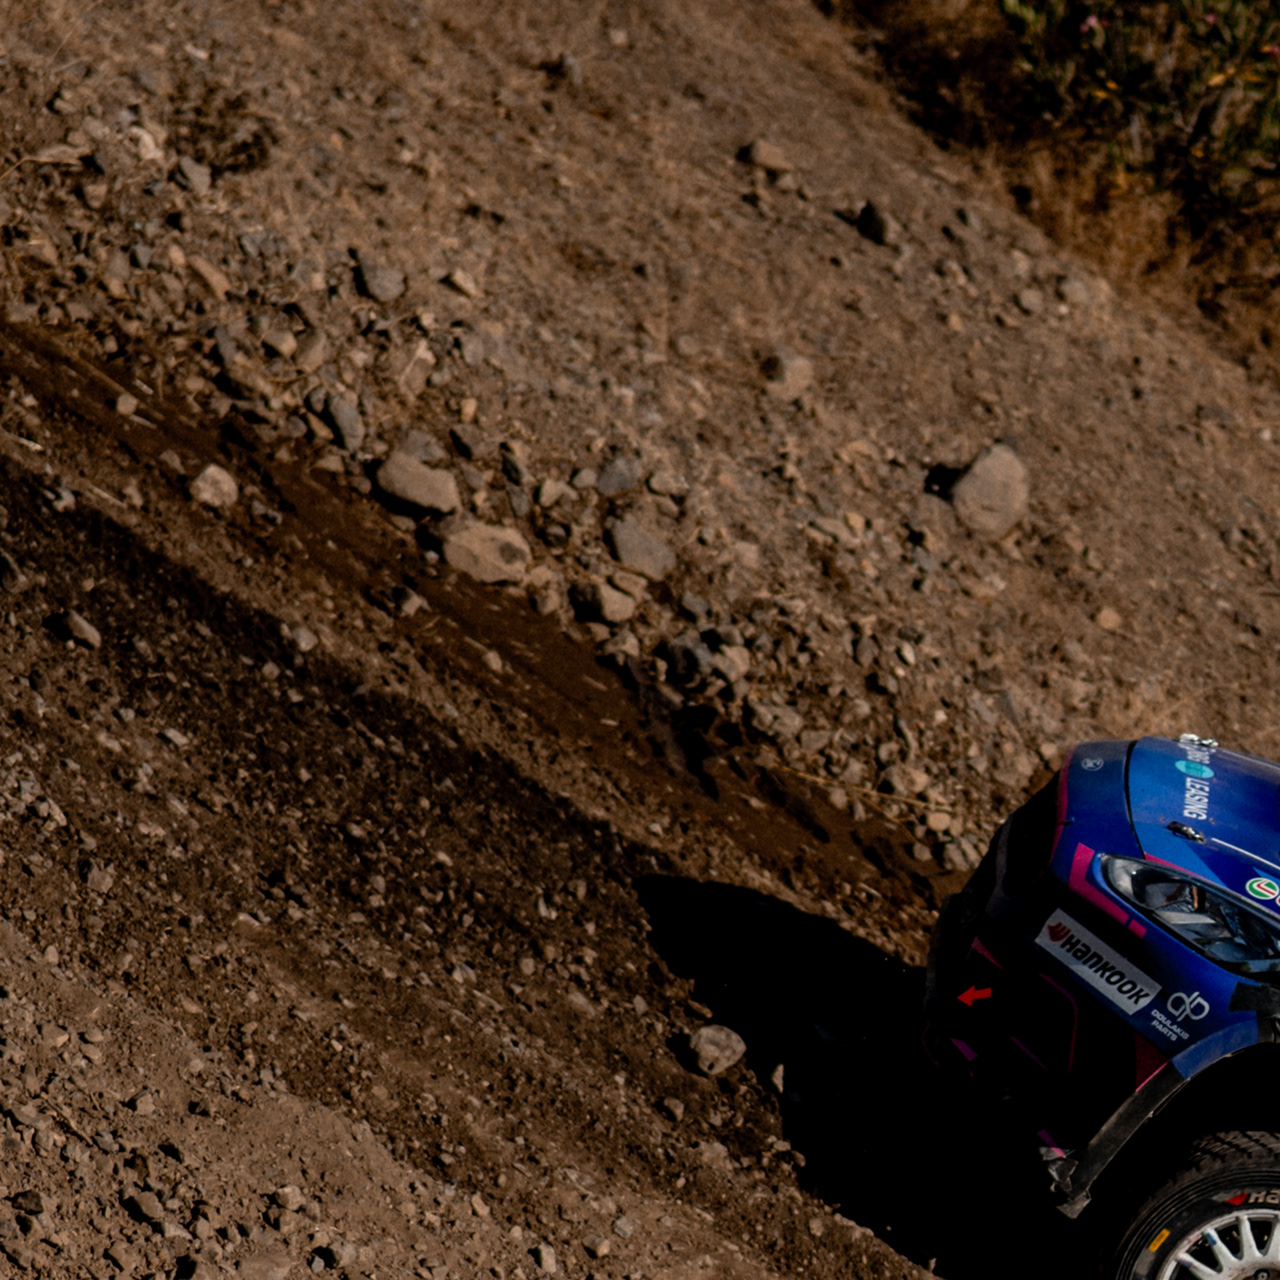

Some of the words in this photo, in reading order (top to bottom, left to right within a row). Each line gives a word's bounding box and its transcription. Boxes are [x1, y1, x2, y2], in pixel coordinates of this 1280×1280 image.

[1183, 777, 1210, 821] LEASING
[1151, 1009, 1190, 1040] DOULAKIS
[1151, 1019, 1178, 1041] PARTS
